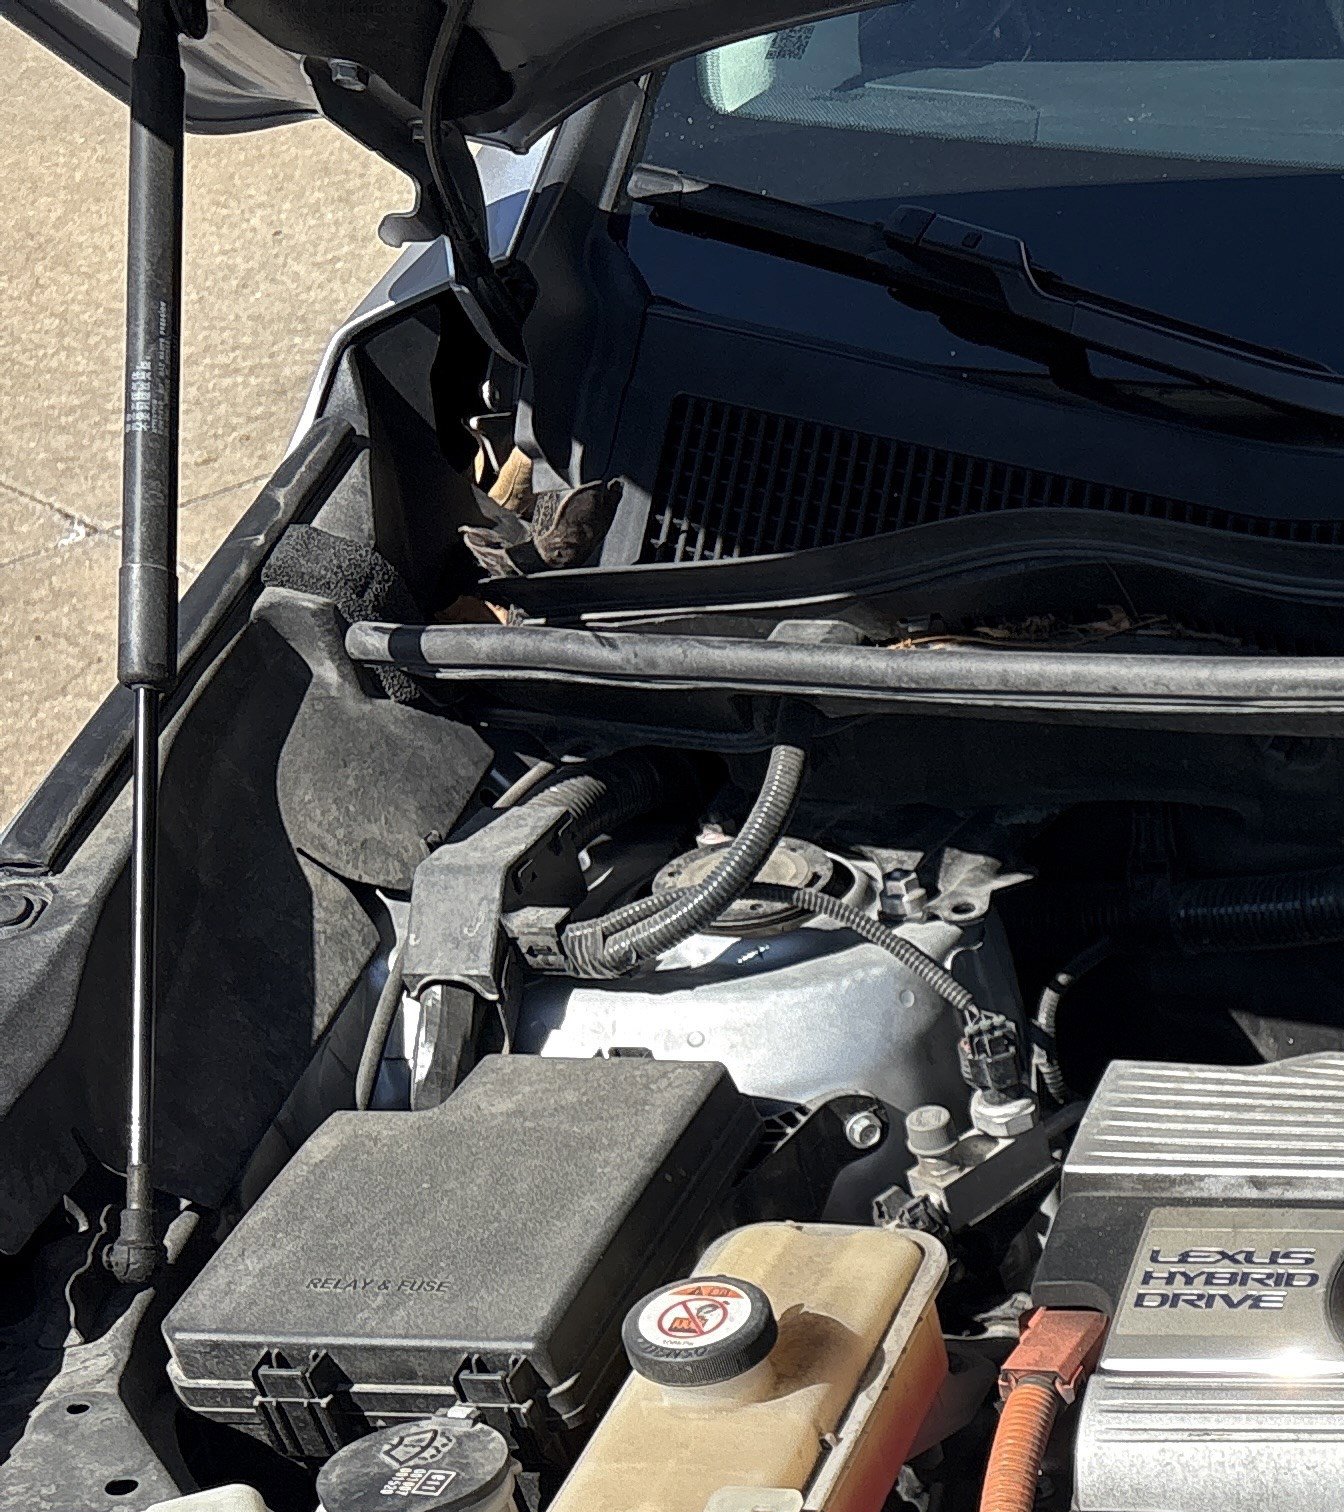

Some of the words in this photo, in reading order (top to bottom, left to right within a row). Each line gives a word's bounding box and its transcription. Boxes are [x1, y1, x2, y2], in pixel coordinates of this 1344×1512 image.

[1149, 1247, 1317, 1265] LEXUS
[305, 1277, 375, 1292] RELAY
[377, 1279, 391, 1291] &
[397, 1280, 452, 1293] FUSE
[1140, 1268, 1320, 1287] HYBRID
[1133, 1289, 1288, 1309] DRIVE
